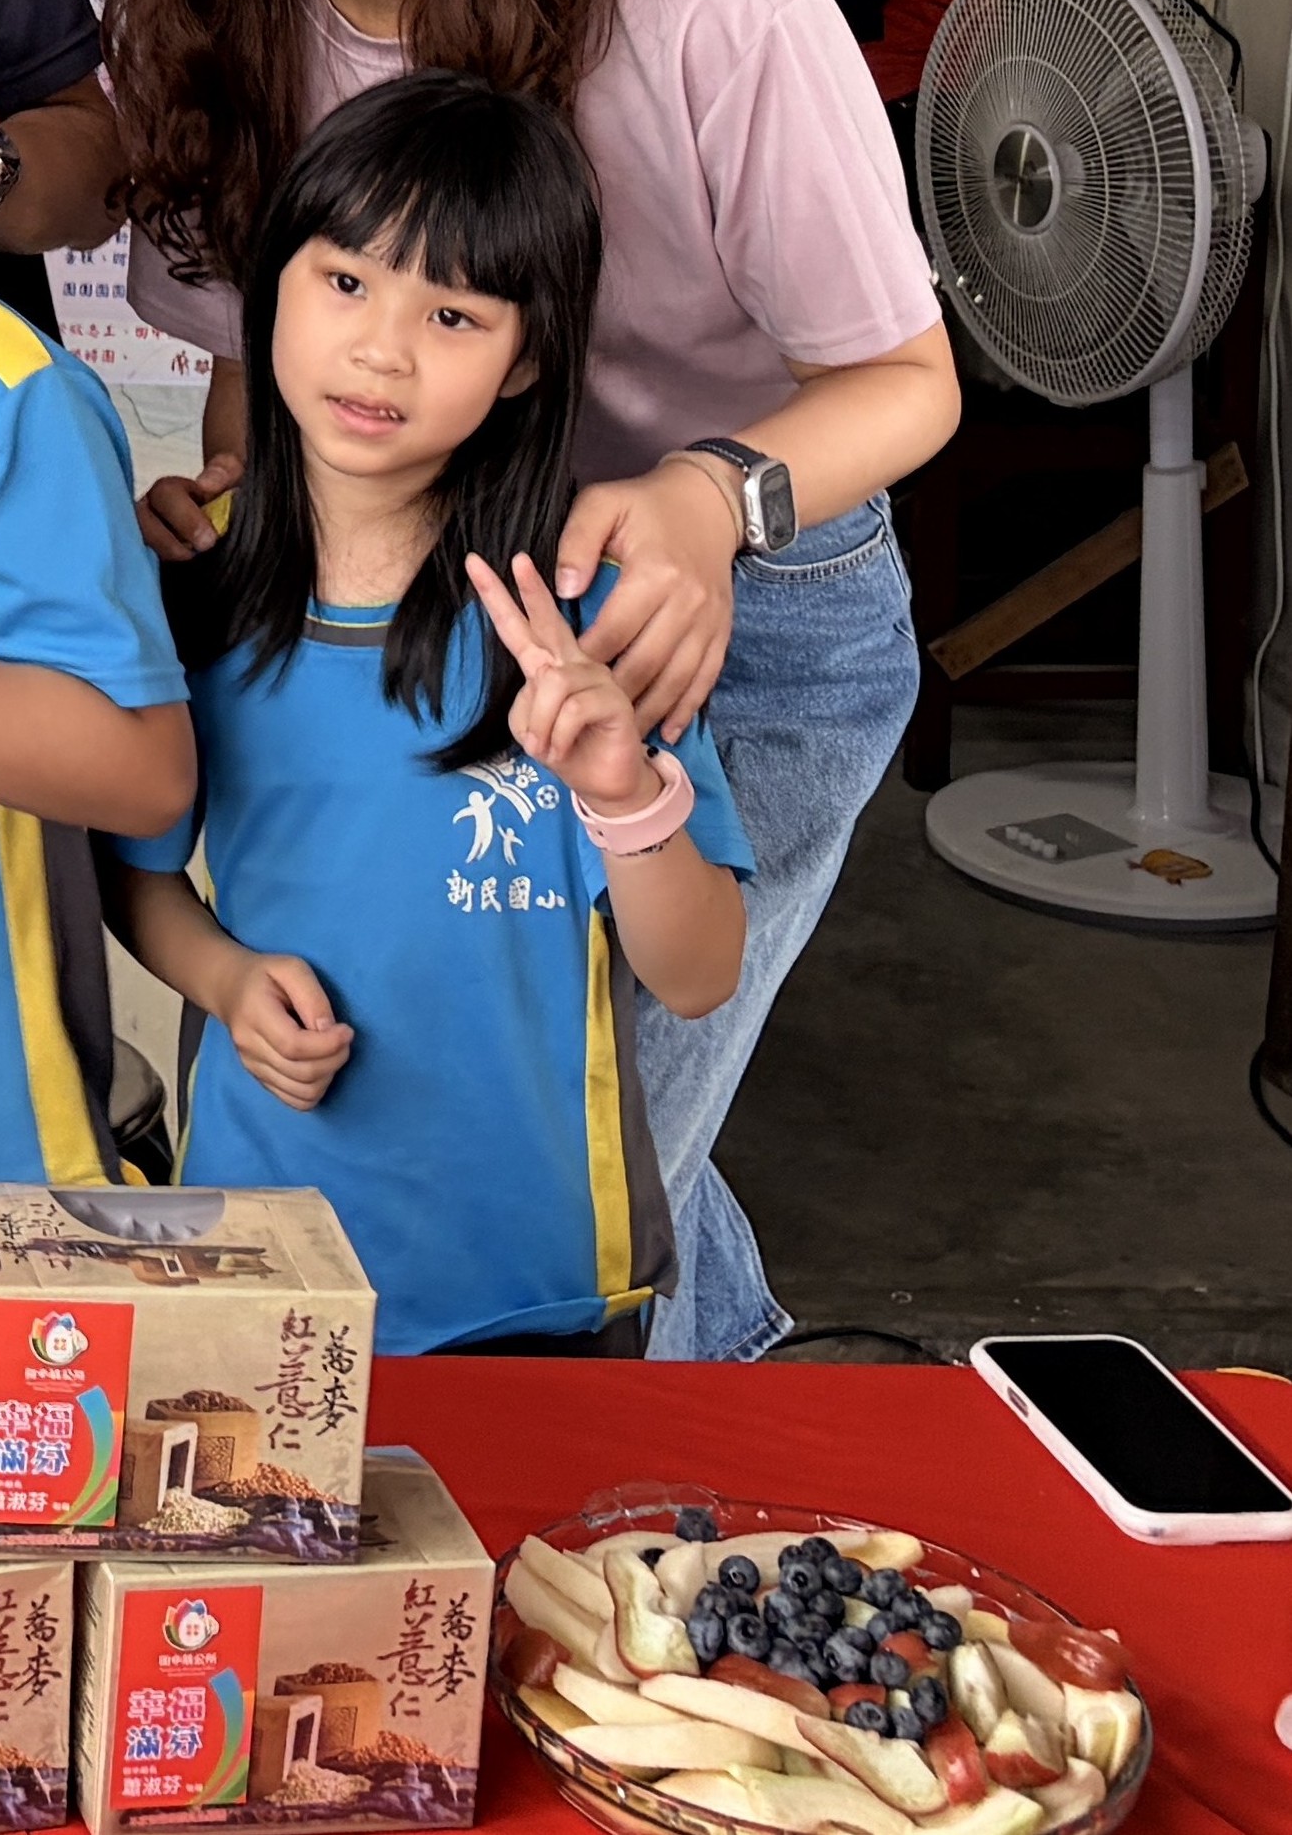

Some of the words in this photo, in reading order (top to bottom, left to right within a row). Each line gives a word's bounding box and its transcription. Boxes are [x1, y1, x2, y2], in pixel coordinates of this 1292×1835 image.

[446, 869, 566, 912] 新民國小
[254, 1307, 317, 1449] 紅薏仁
[307, 1325, 358, 1436] 蕎麥
[15, 1594, 62, 1706] 蕎麥
[377, 1578, 436, 1717] 紅薏仁
[427, 1592, 476, 1703] 蕎麥
[128, 1687, 206, 1724] 幸福
